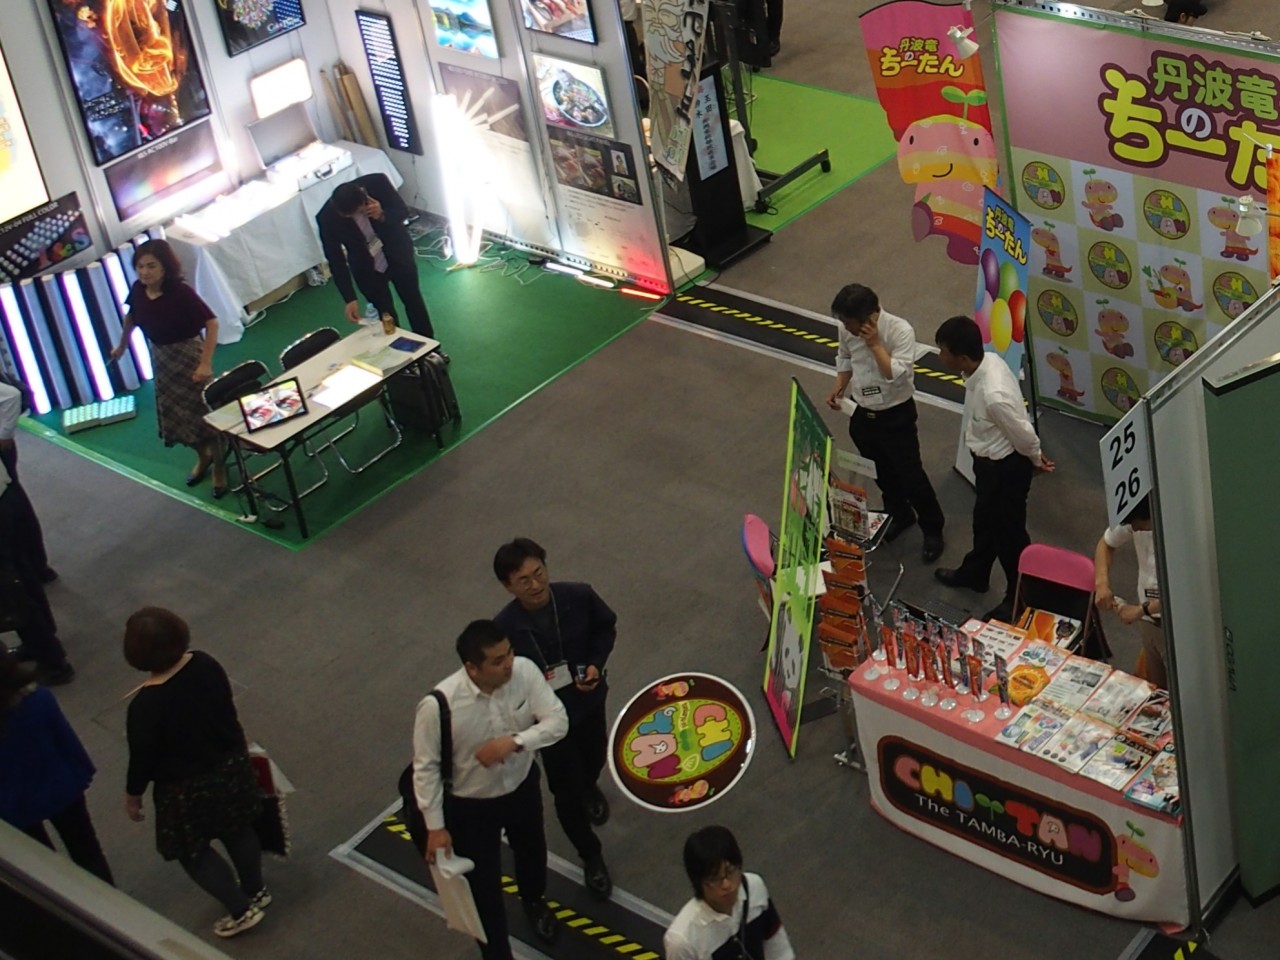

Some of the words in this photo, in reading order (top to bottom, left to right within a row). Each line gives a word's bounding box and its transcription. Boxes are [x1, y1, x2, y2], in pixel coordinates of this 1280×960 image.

[880, 47, 964, 77] ちーたん
[899, 36, 940, 53] 丹波竜
[1152, 56, 1279, 121] 丹波竜
[1180, 107, 1212, 138] の
[985, 204, 1028, 266] ちーたん
[995, 203, 1016, 232] 丹波竜
[1109, 420, 1137, 471] 25
[1114, 467, 1141, 516] 26
[914, 793, 951, 817] The
[956, 810, 1064, 866] TAMBA-RYU
[1004, 800, 1102, 863] TAN
